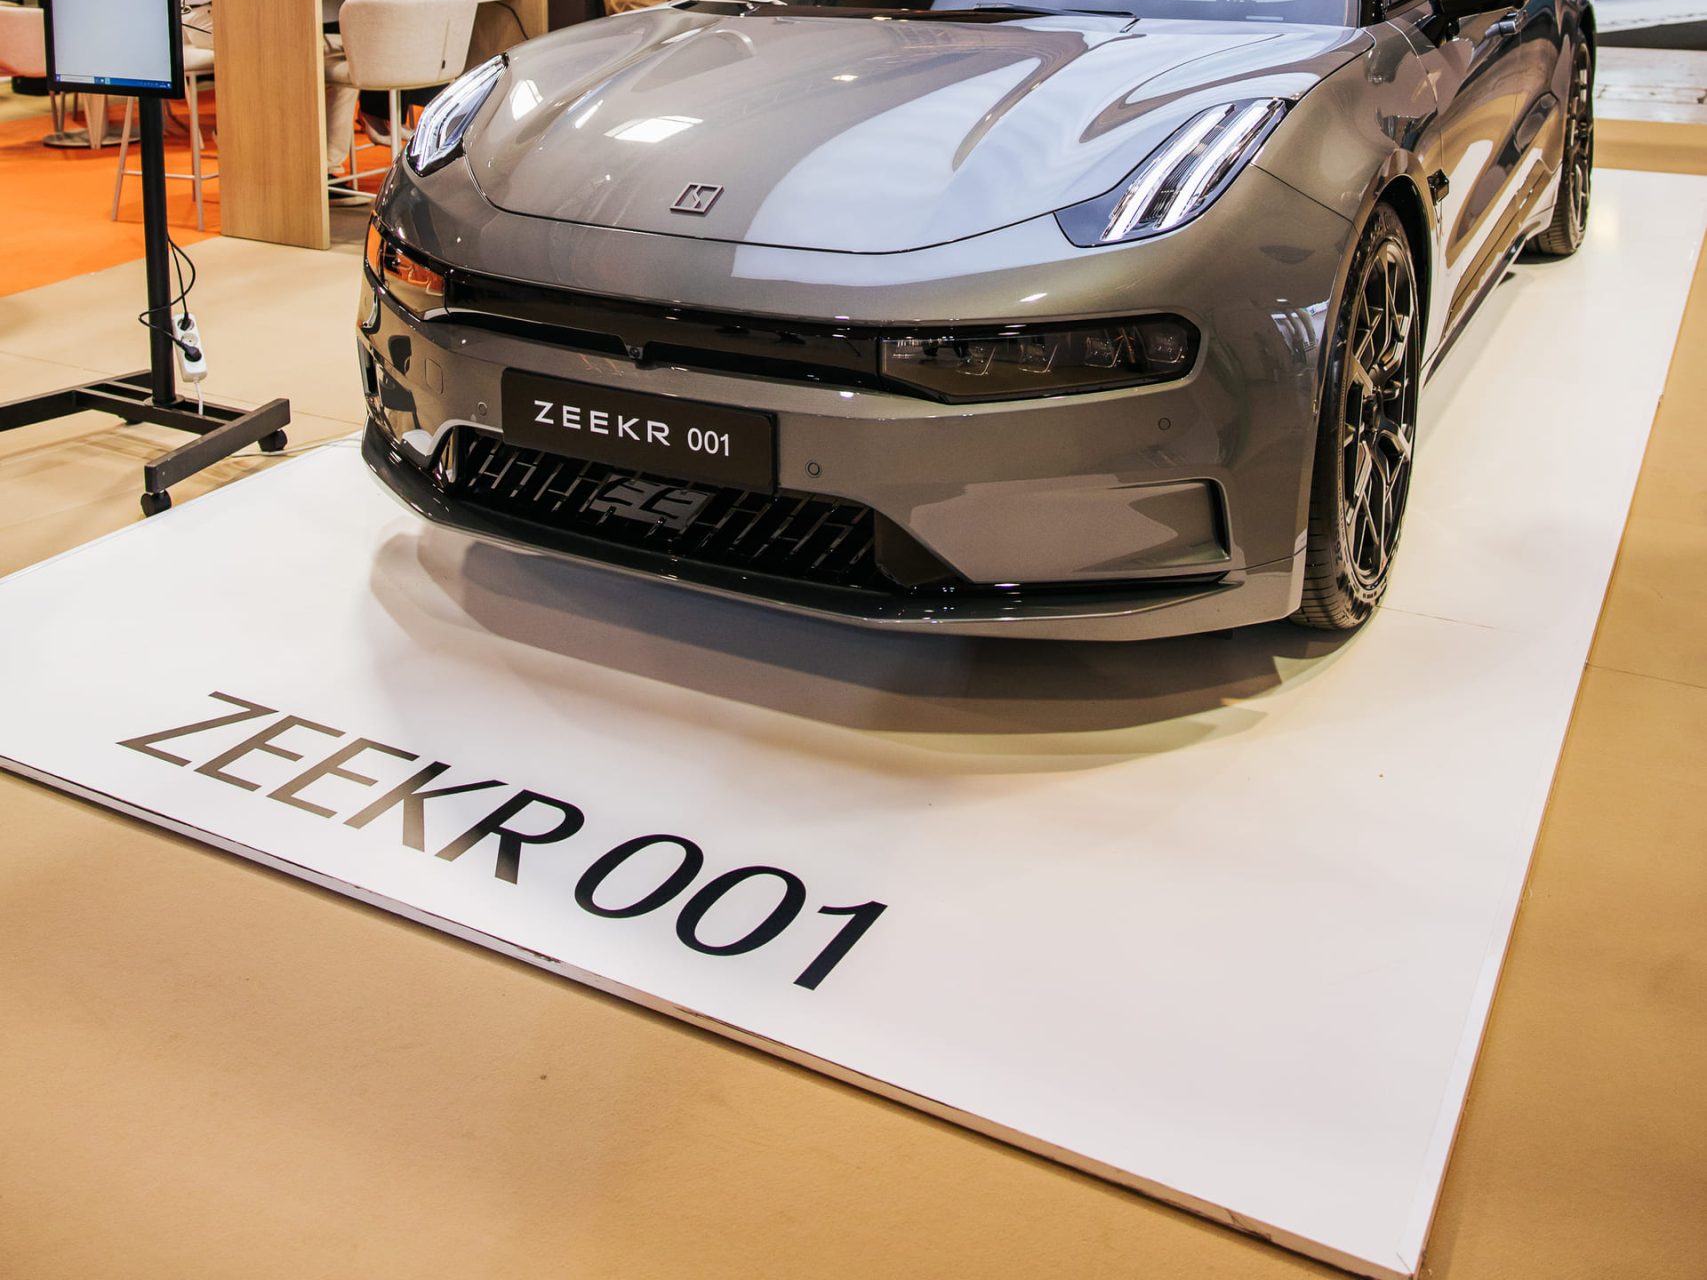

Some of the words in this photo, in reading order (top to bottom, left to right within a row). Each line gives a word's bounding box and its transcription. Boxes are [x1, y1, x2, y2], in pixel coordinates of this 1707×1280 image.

[534, 399, 671, 447] ZEEKR
[687, 427, 730, 457] 001
[116, 691, 586, 885] ZEEKR
[573, 833, 888, 991] 001
